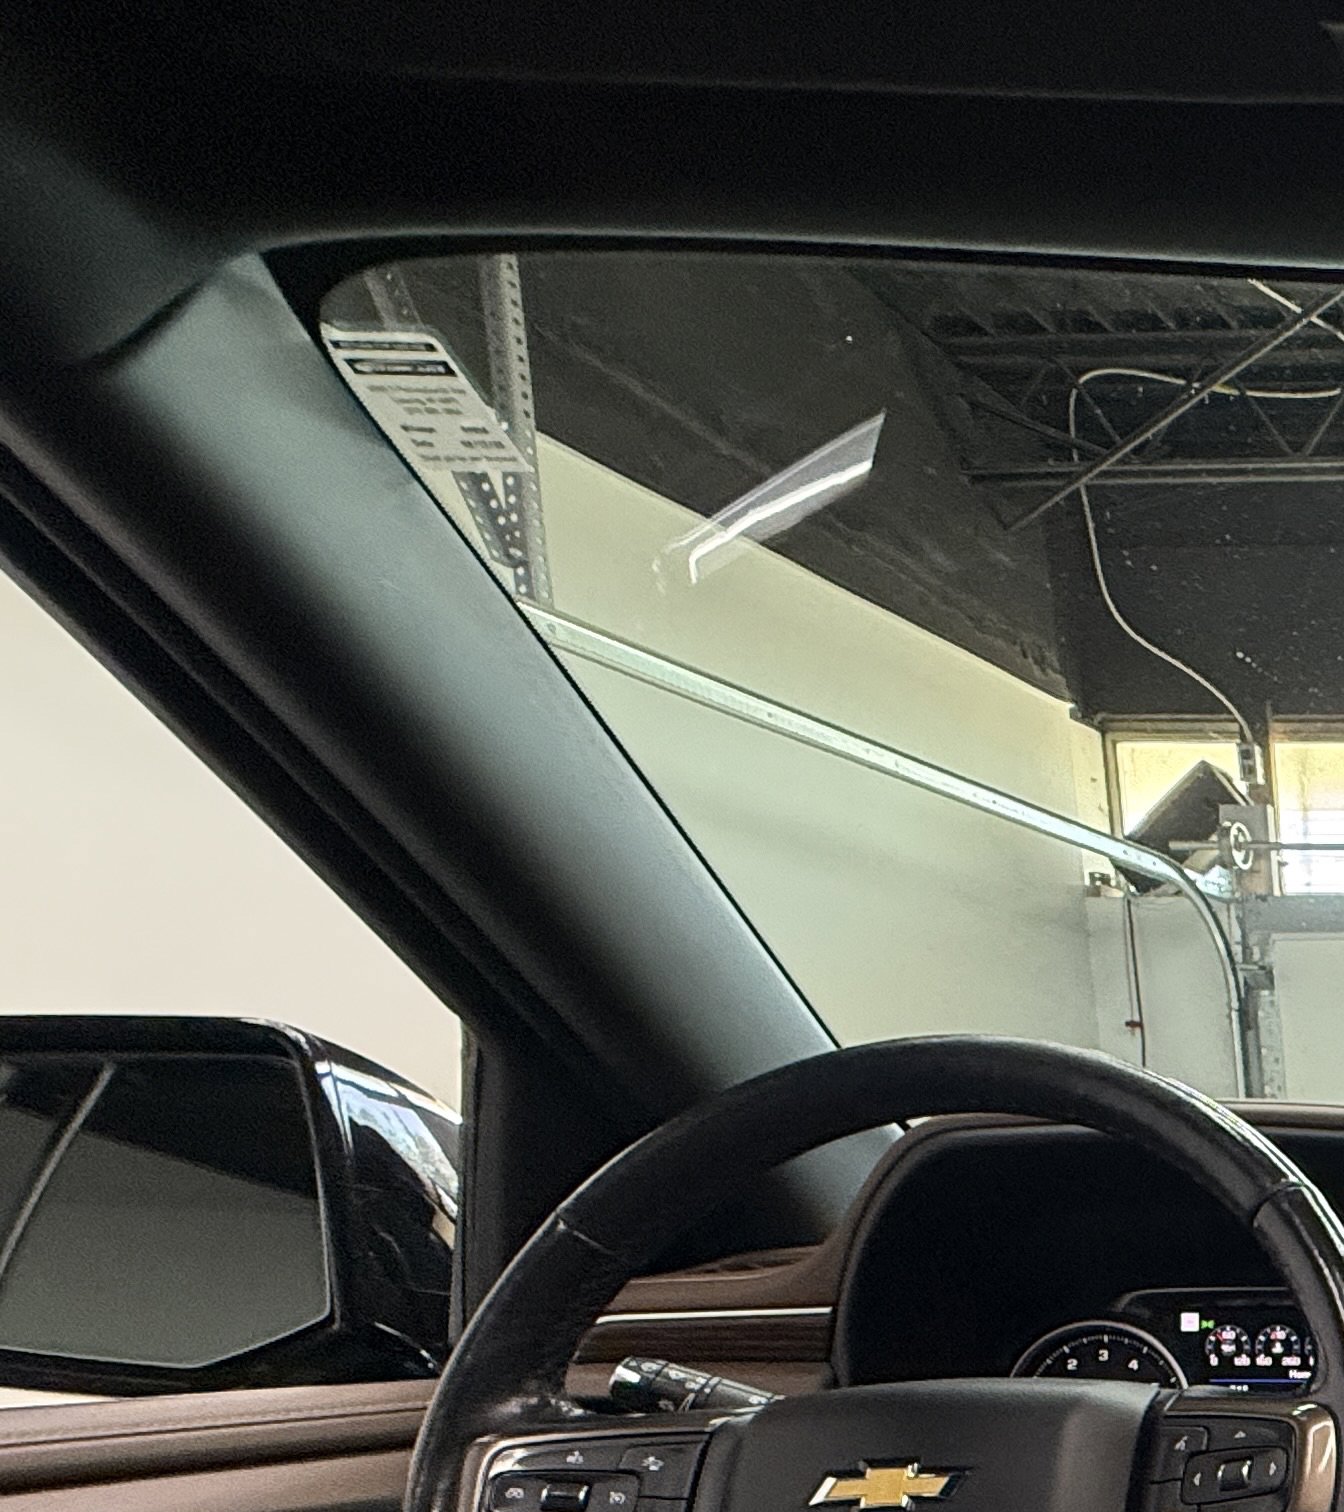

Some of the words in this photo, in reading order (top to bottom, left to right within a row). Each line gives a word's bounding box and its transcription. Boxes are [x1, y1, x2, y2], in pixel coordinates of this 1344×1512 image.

[1097, 1349, 1110, 1361] 3
[1068, 1358, 1081, 1370] 2
[1128, 1359, 1139, 1372] 4
